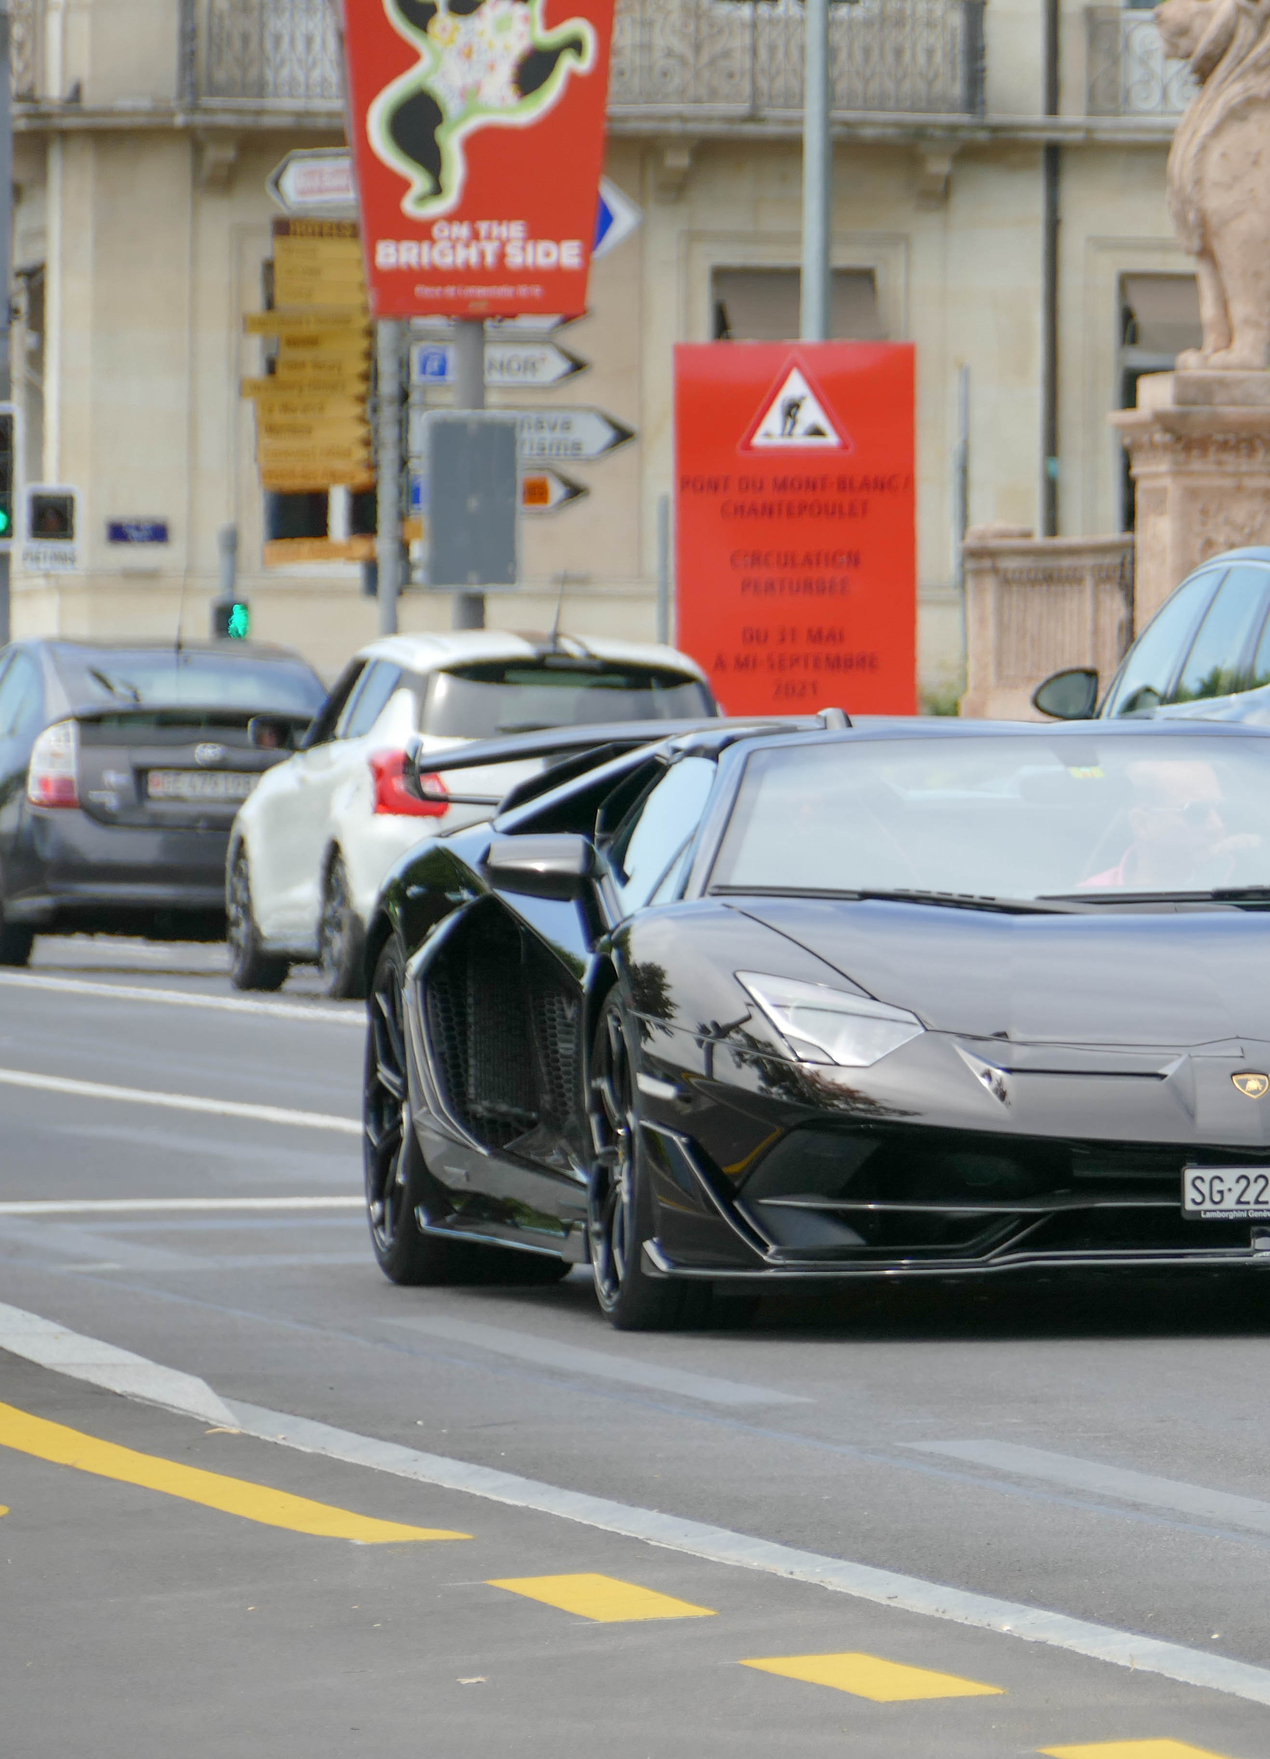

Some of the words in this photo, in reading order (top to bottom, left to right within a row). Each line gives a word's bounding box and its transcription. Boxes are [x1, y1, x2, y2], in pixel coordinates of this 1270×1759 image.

[432, 220, 471, 240] ON
[476, 220, 527, 240] THE
[375, 240, 500, 270] BRIGHT
[504, 240, 583, 270] SIDE
[680, 475, 730, 492] PONT
[738, 475, 765, 492] DU
[720, 500, 869, 519] CHANTEPOULET
[730, 550, 861, 570] CIRCULATION
[742, 627, 768, 645] DU
[778, 627, 797, 645] 31
[807, 627, 844, 644] MAI
[733, 653, 878, 672] MI-SEPTEMBRE
[772, 680, 819, 700] 2021
[1201, 1210, 1247, 1219] Lamborghini
